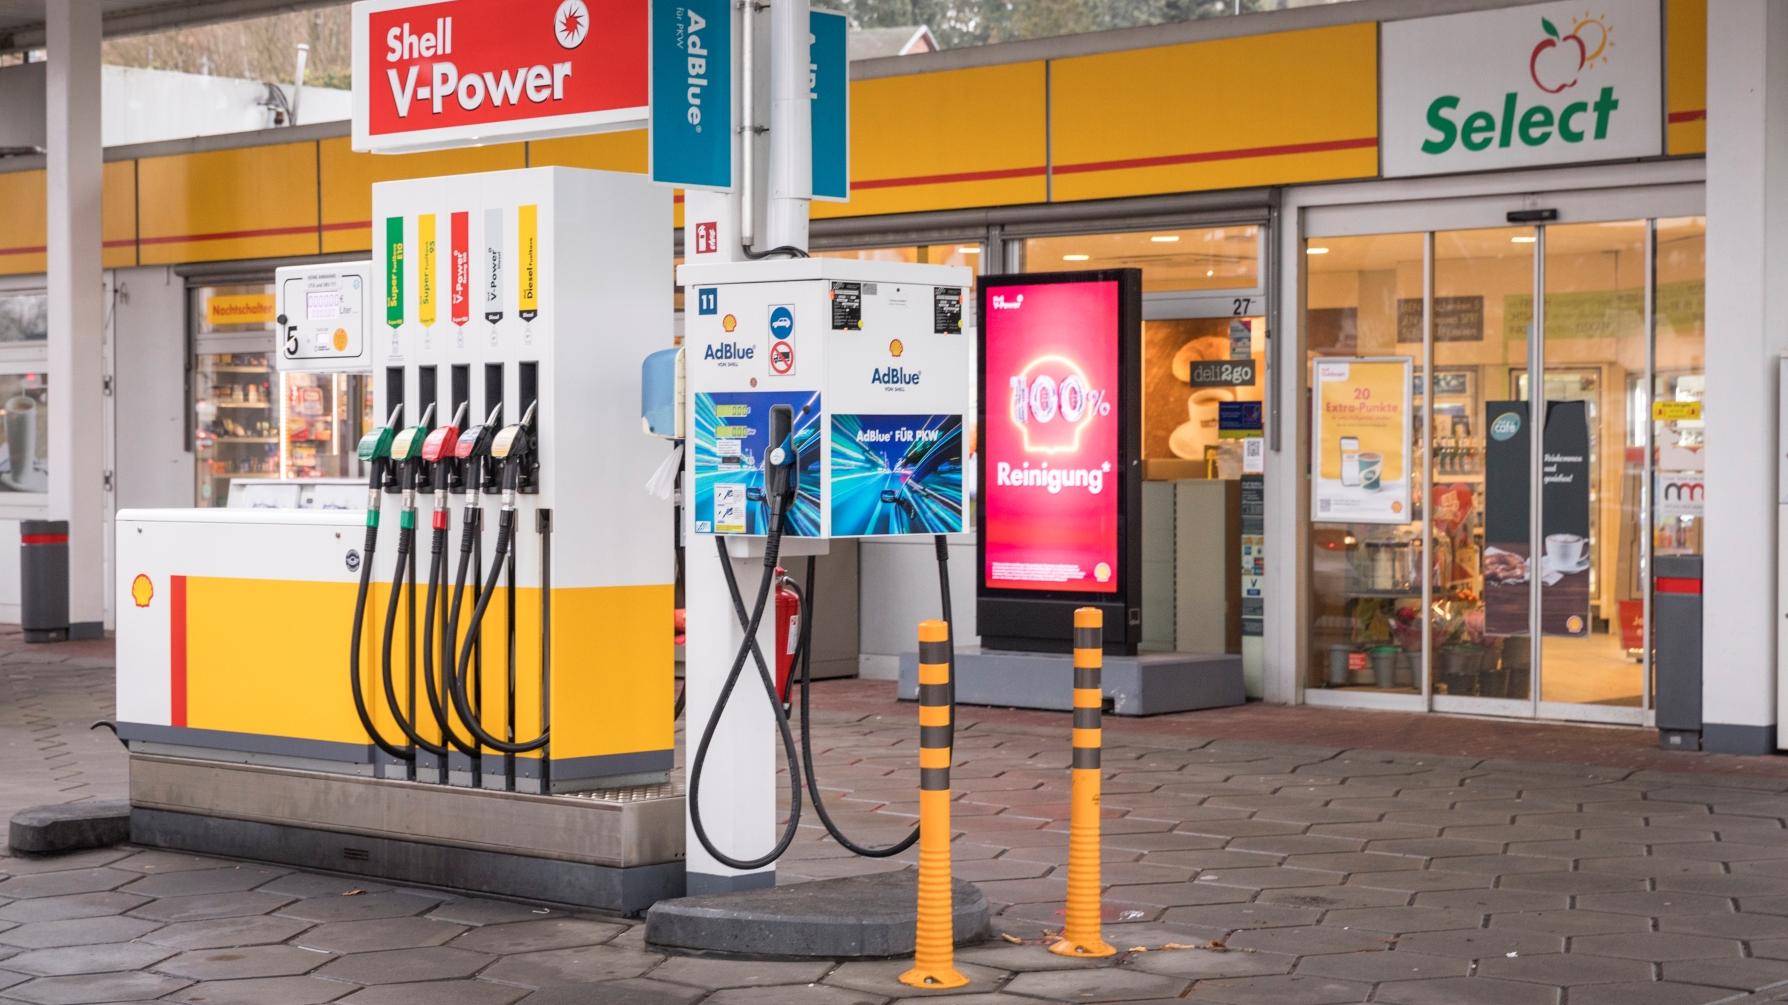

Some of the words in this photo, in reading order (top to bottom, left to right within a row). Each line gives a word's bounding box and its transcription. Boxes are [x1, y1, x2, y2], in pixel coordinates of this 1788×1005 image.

[676, 7, 684, 20] für
[386, 16, 452, 62] Shell
[676, 23, 684, 49] PKW
[386, 61, 572, 118] V-Power
[1420, 86, 1620, 155] Select
[390, 273, 399, 307] Super
[212, 301, 273, 317] Nachtschalter
[701, 294, 715, 310] 11
[1233, 298, 1251, 316] 27
[286, 325, 299, 356] 5
[1194, 364, 1252, 384] deli2go
[1009, 374, 1111, 424] 100%
[1353, 387, 1371, 401] 20
[1325, 401, 1399, 413] Extra-Punkte
[895, 427, 914, 442] FÜR
[916, 429, 940, 442] PKW
